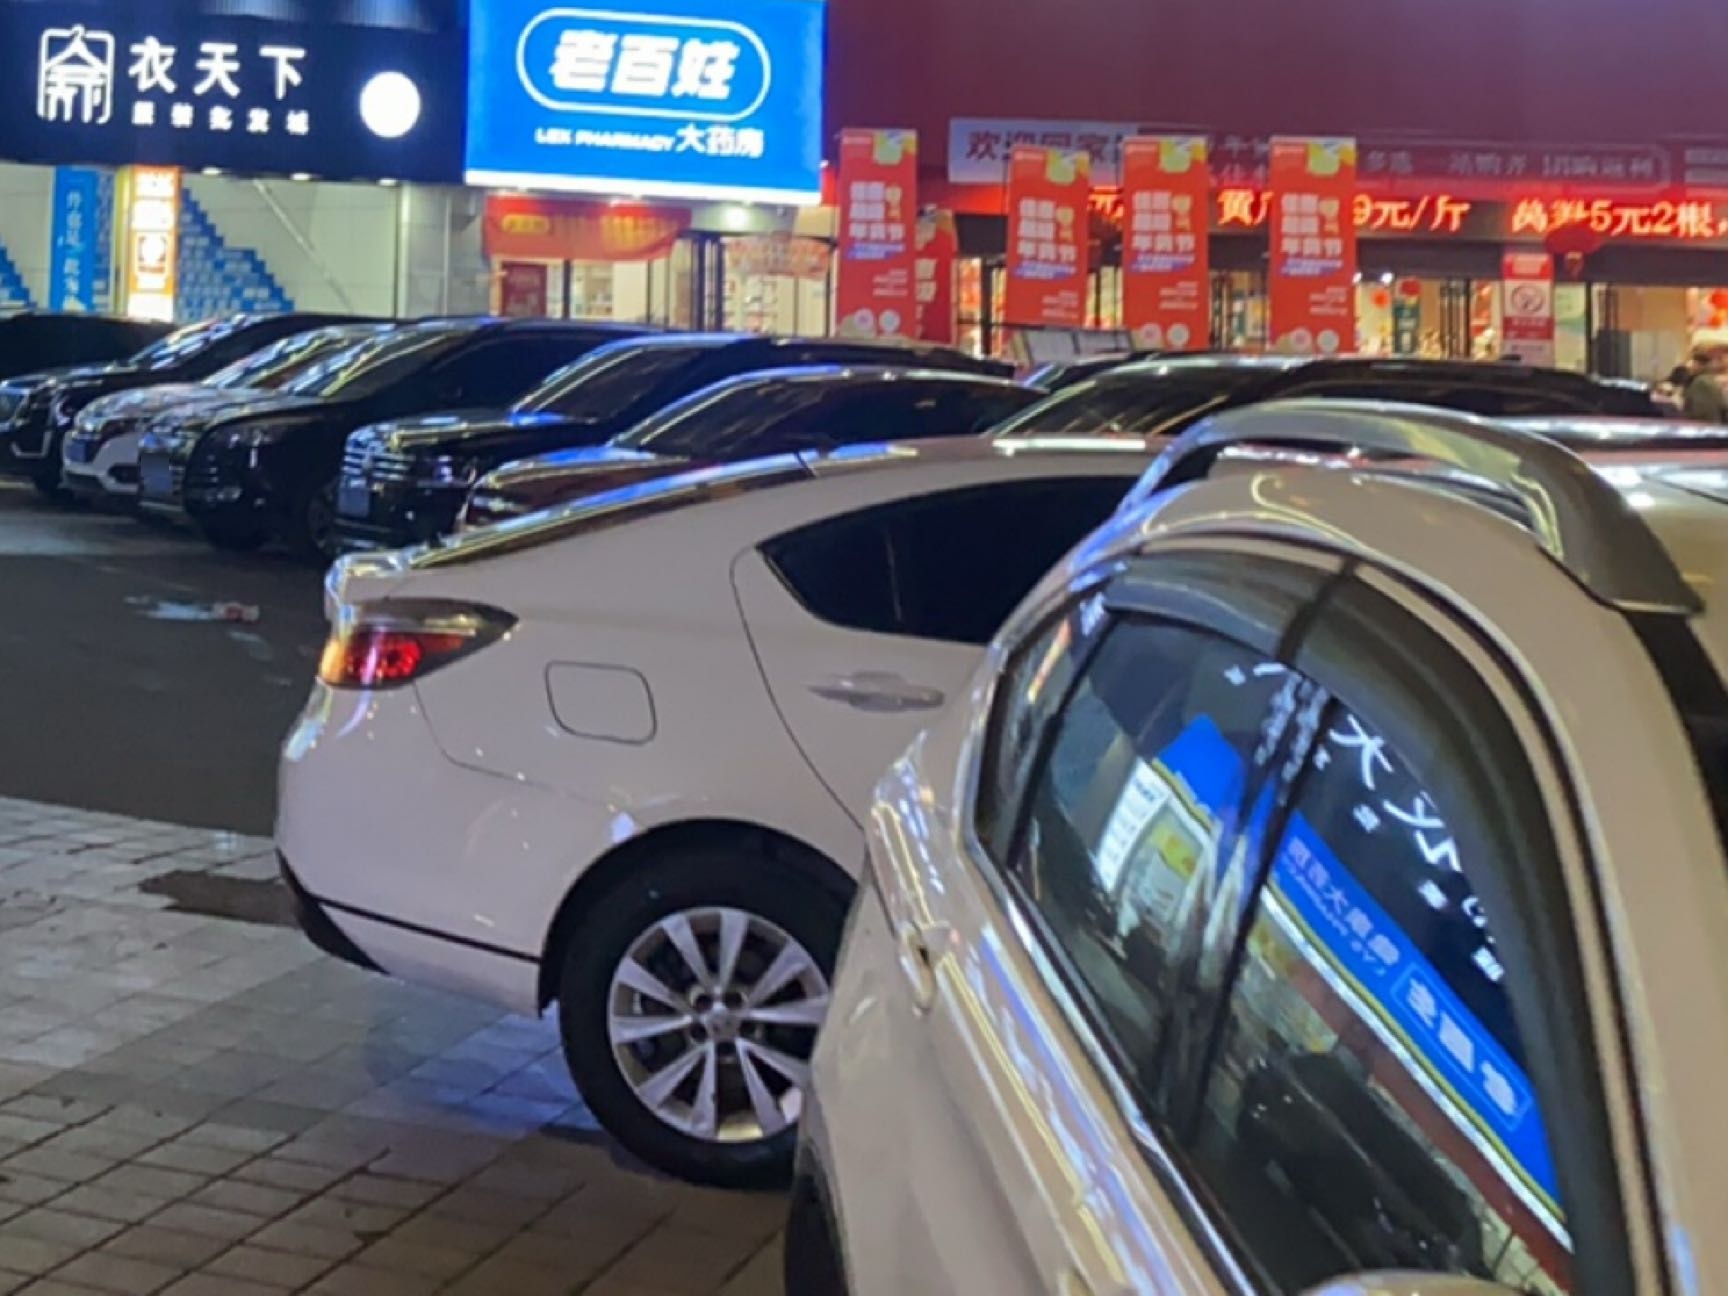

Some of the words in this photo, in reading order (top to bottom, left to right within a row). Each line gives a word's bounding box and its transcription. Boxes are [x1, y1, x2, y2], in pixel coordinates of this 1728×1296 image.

[128, 36, 306, 100] 衣天下
[548, 28, 742, 100] 老百姓
[676, 122, 764, 158] 大药房
